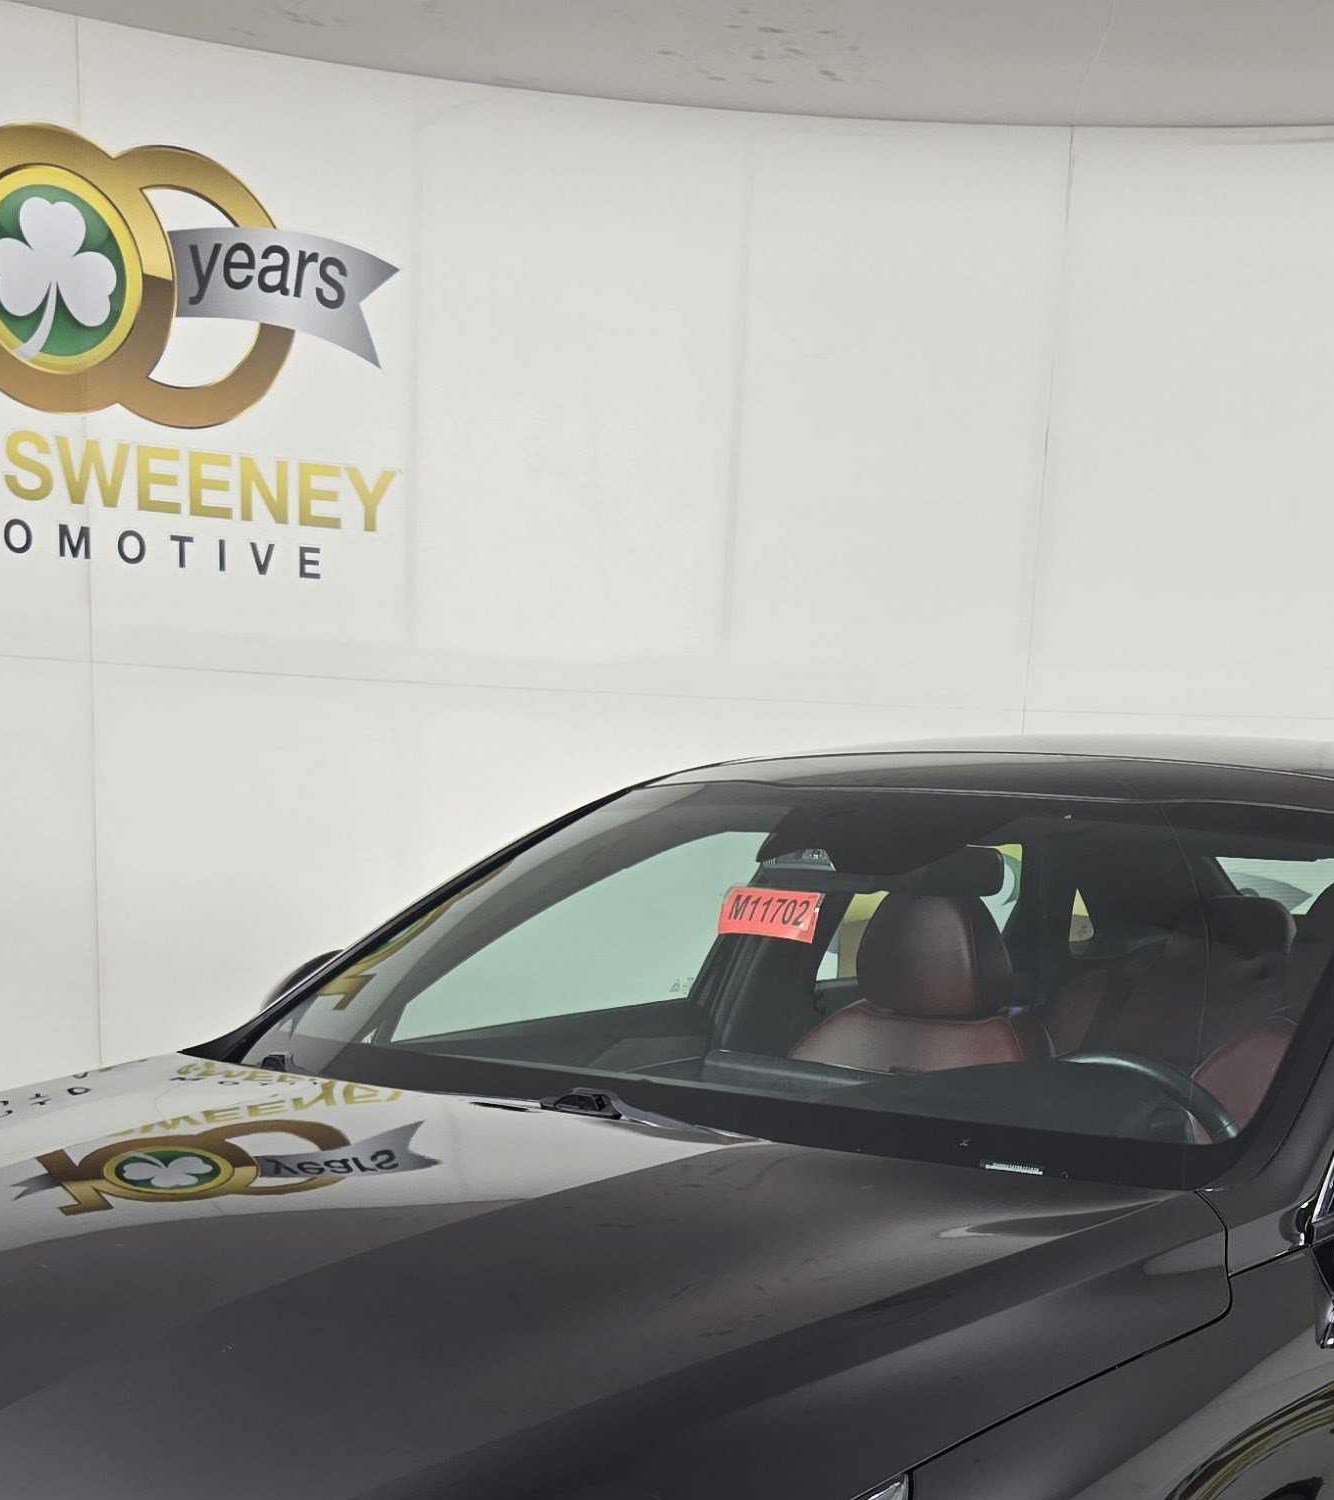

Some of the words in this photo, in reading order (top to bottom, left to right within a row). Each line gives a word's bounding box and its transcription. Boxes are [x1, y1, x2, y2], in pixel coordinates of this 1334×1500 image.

[188, 241, 348, 309] years
[3, 430, 398, 533] SWEENEY
[728, 894, 810, 926] M11702
